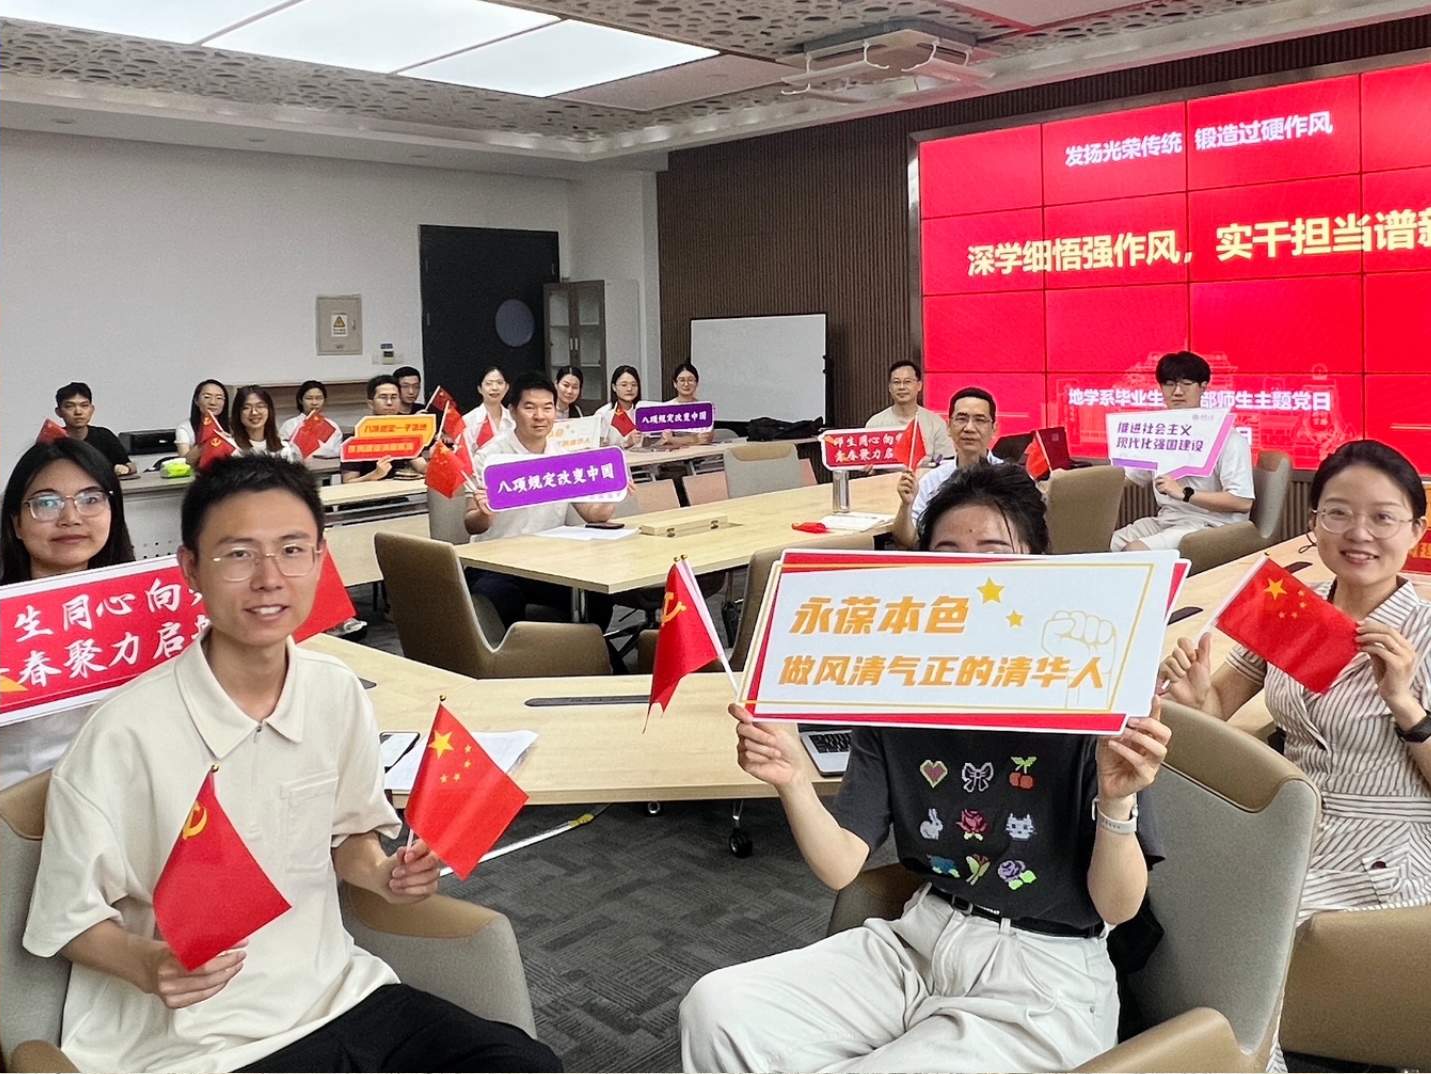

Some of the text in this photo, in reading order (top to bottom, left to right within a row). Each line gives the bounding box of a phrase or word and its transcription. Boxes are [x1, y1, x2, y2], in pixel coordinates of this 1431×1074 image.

[1065, 111, 1333, 167] 发扬光荣传统 锻造过硬作风
[1116, 437, 1204, 453] 现代化强国建设
[1117, 422, 1192, 437] 推进社会主义
[497, 463, 615, 495] 八项规定改变中国
[14, 577, 203, 643] 生同心向
[789, 595, 970, 635] 永葆本色
[0, 614, 212, 688] 春聚力启
[778, 654, 1105, 690] 做风清气正的清华人
